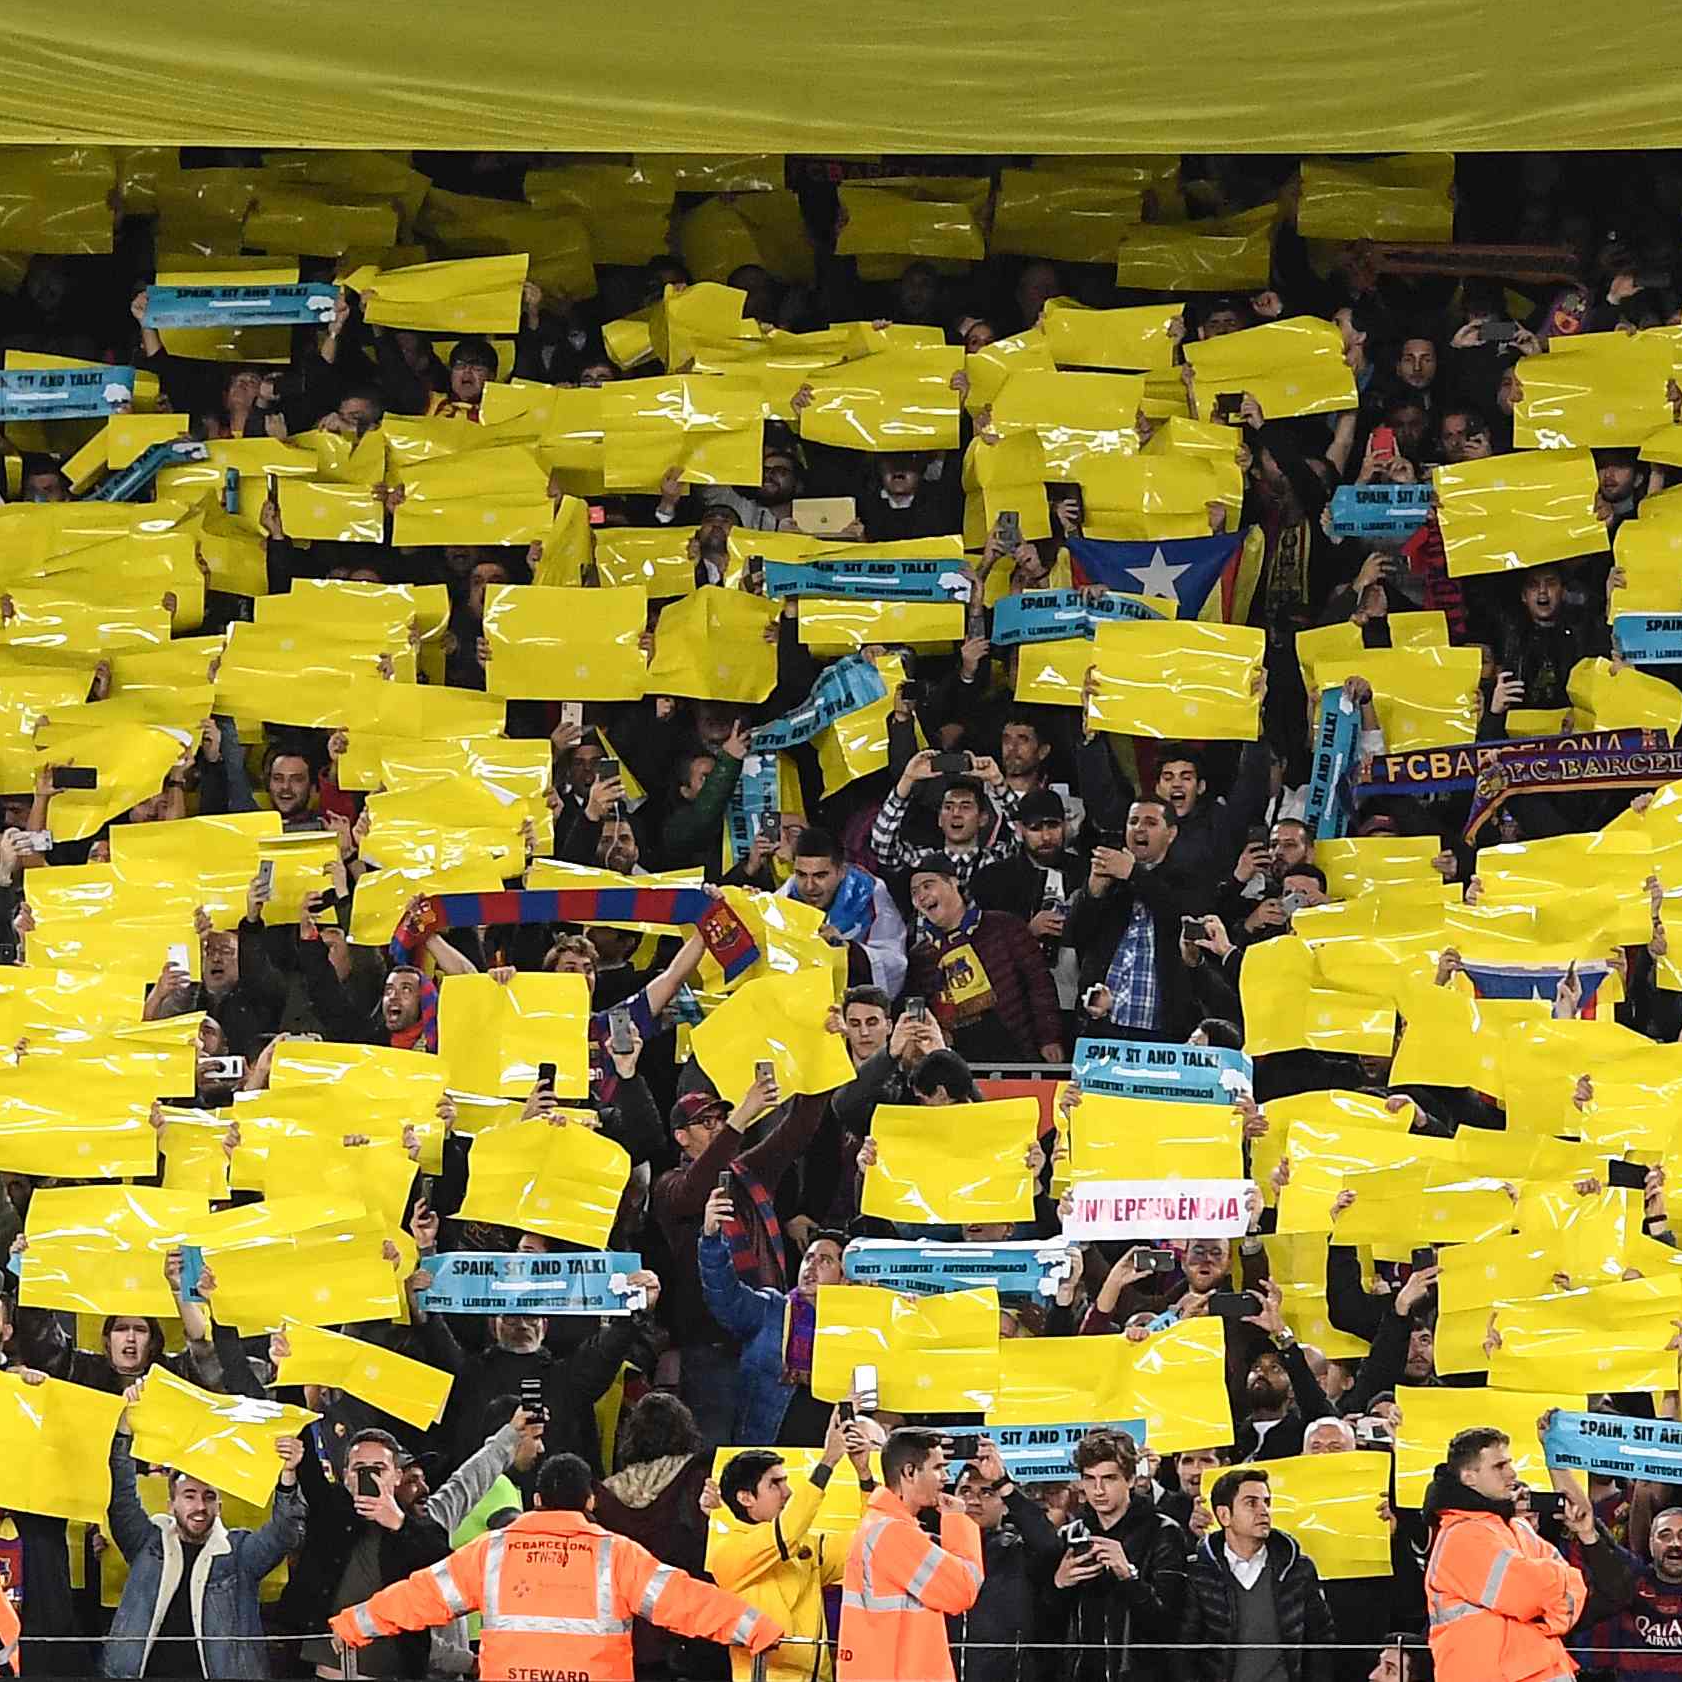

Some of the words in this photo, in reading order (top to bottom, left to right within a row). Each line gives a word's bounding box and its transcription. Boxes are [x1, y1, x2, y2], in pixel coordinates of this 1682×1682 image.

[844, 562, 863, 574] SIT
[867, 562, 896, 575] AND
[901, 561, 938, 575] TALK!
[1020, 595, 1062, 612] SPAIN,
[1322, 712, 1338, 749] TALK!
[1147, 1049, 1177, 1066] AND
[451, 1259, 499, 1278] SPAIN,
[529, 1258, 562, 1276] AND
[567, 1258, 607, 1275] TALK!
[999, 1430, 1023, 1446] SIT
[1027, 1429, 1060, 1446] AND
[1579, 1418, 1628, 1441] SPAIN,
[1633, 1424, 1654, 1444] SIT
[507, 1667, 590, 1682] STEWARD
